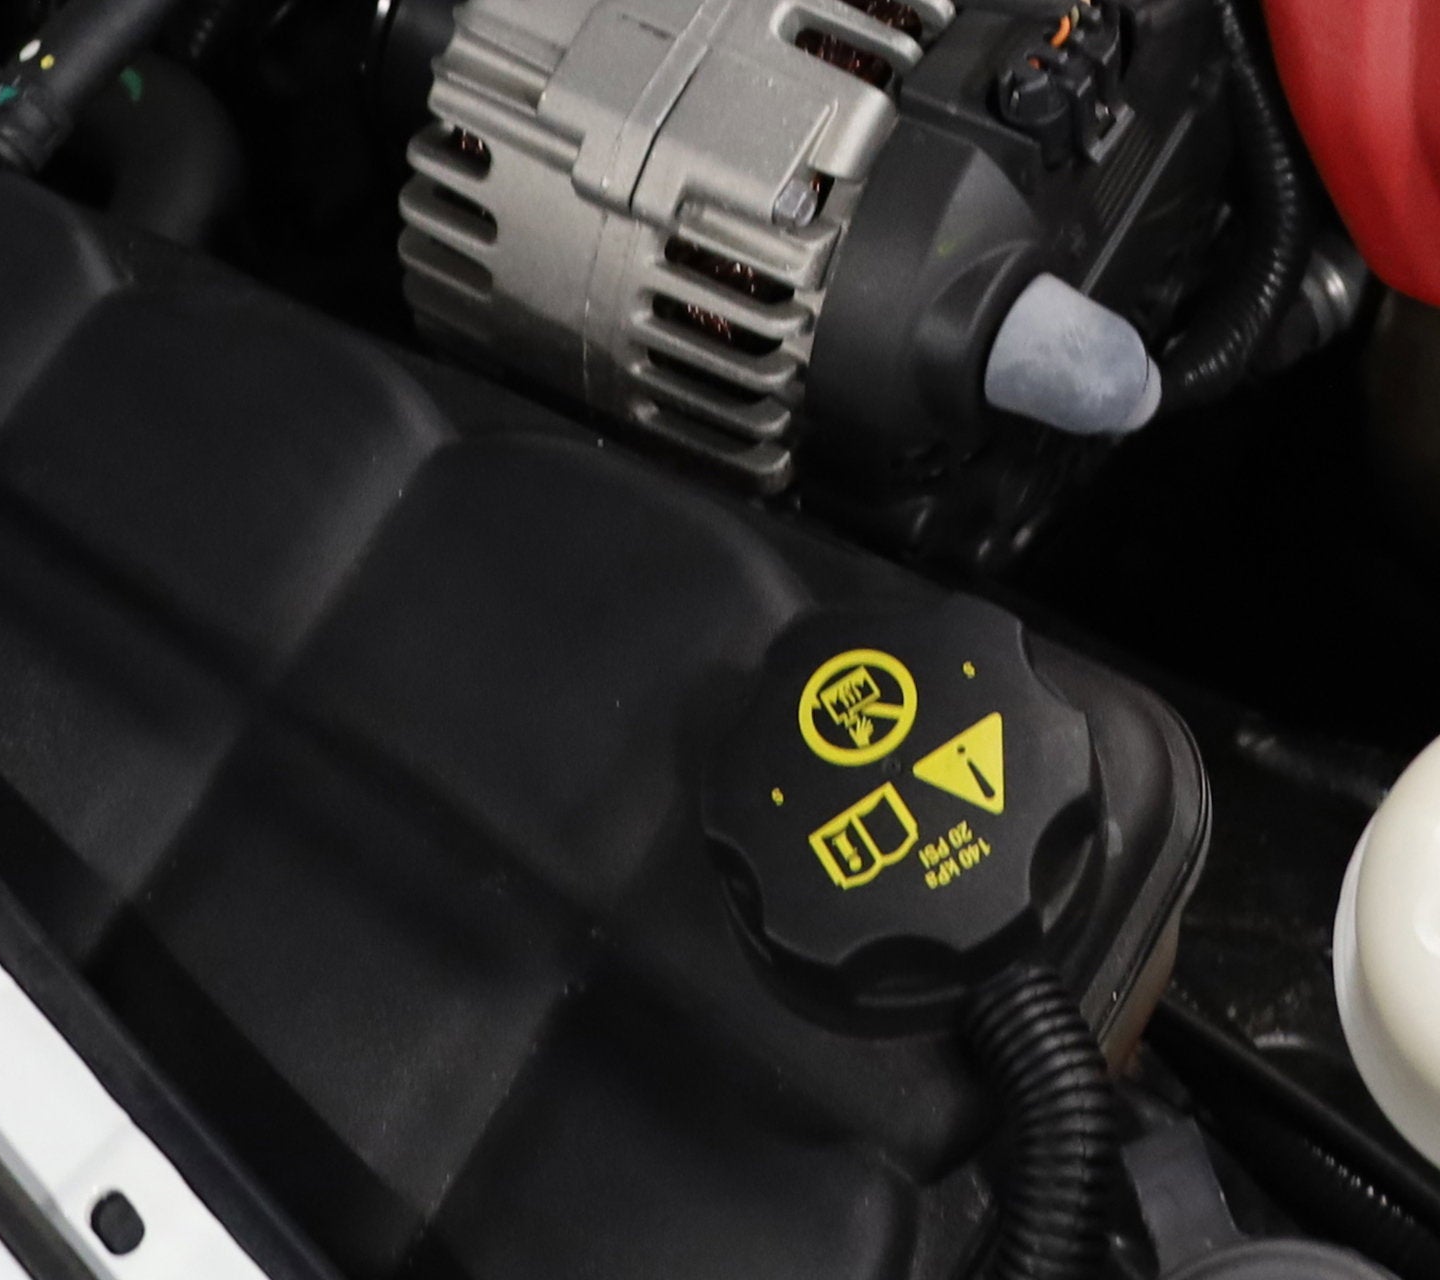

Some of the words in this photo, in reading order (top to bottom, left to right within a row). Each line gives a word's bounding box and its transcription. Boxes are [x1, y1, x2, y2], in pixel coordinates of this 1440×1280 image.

[948, 820, 973, 850] 20
[918, 836, 950, 870] PSI
[958, 836, 991, 870] 140
